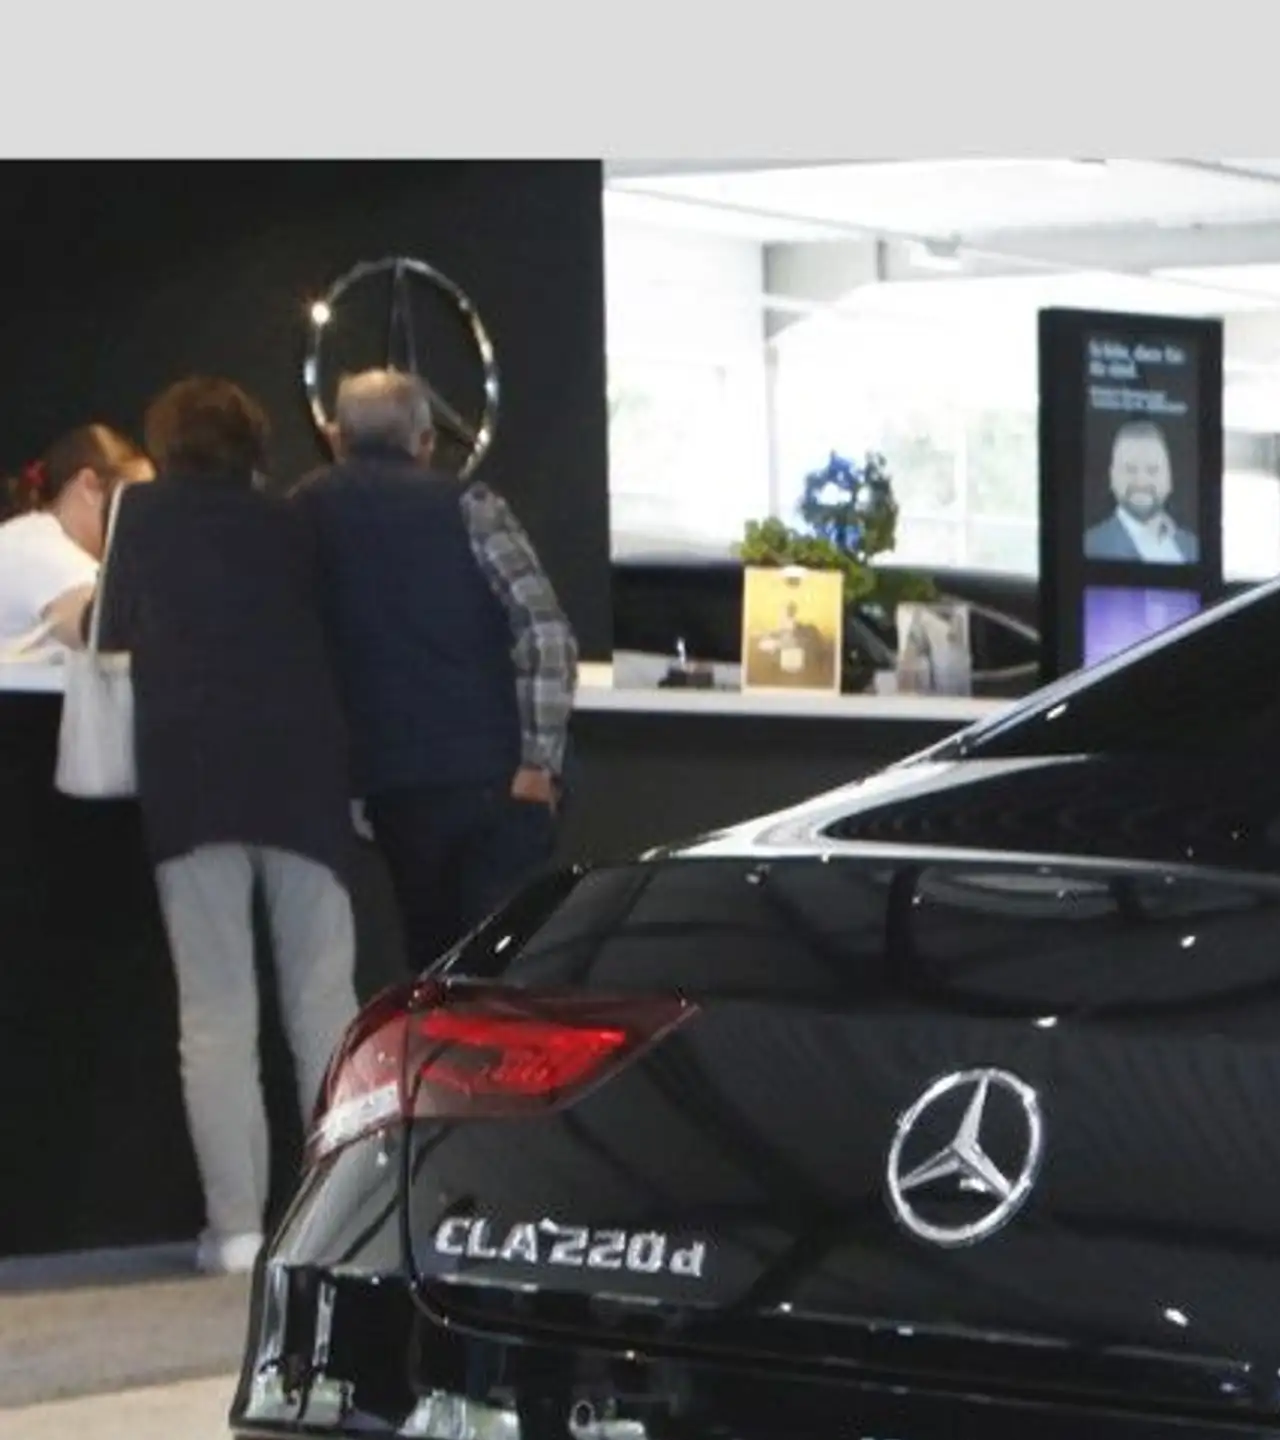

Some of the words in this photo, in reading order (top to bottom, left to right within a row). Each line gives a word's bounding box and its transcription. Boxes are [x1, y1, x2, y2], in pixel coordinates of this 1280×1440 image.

[435, 1216, 539, 1264] CLA
[548, 1225, 667, 1274] 220
[668, 1240, 706, 1278] d
